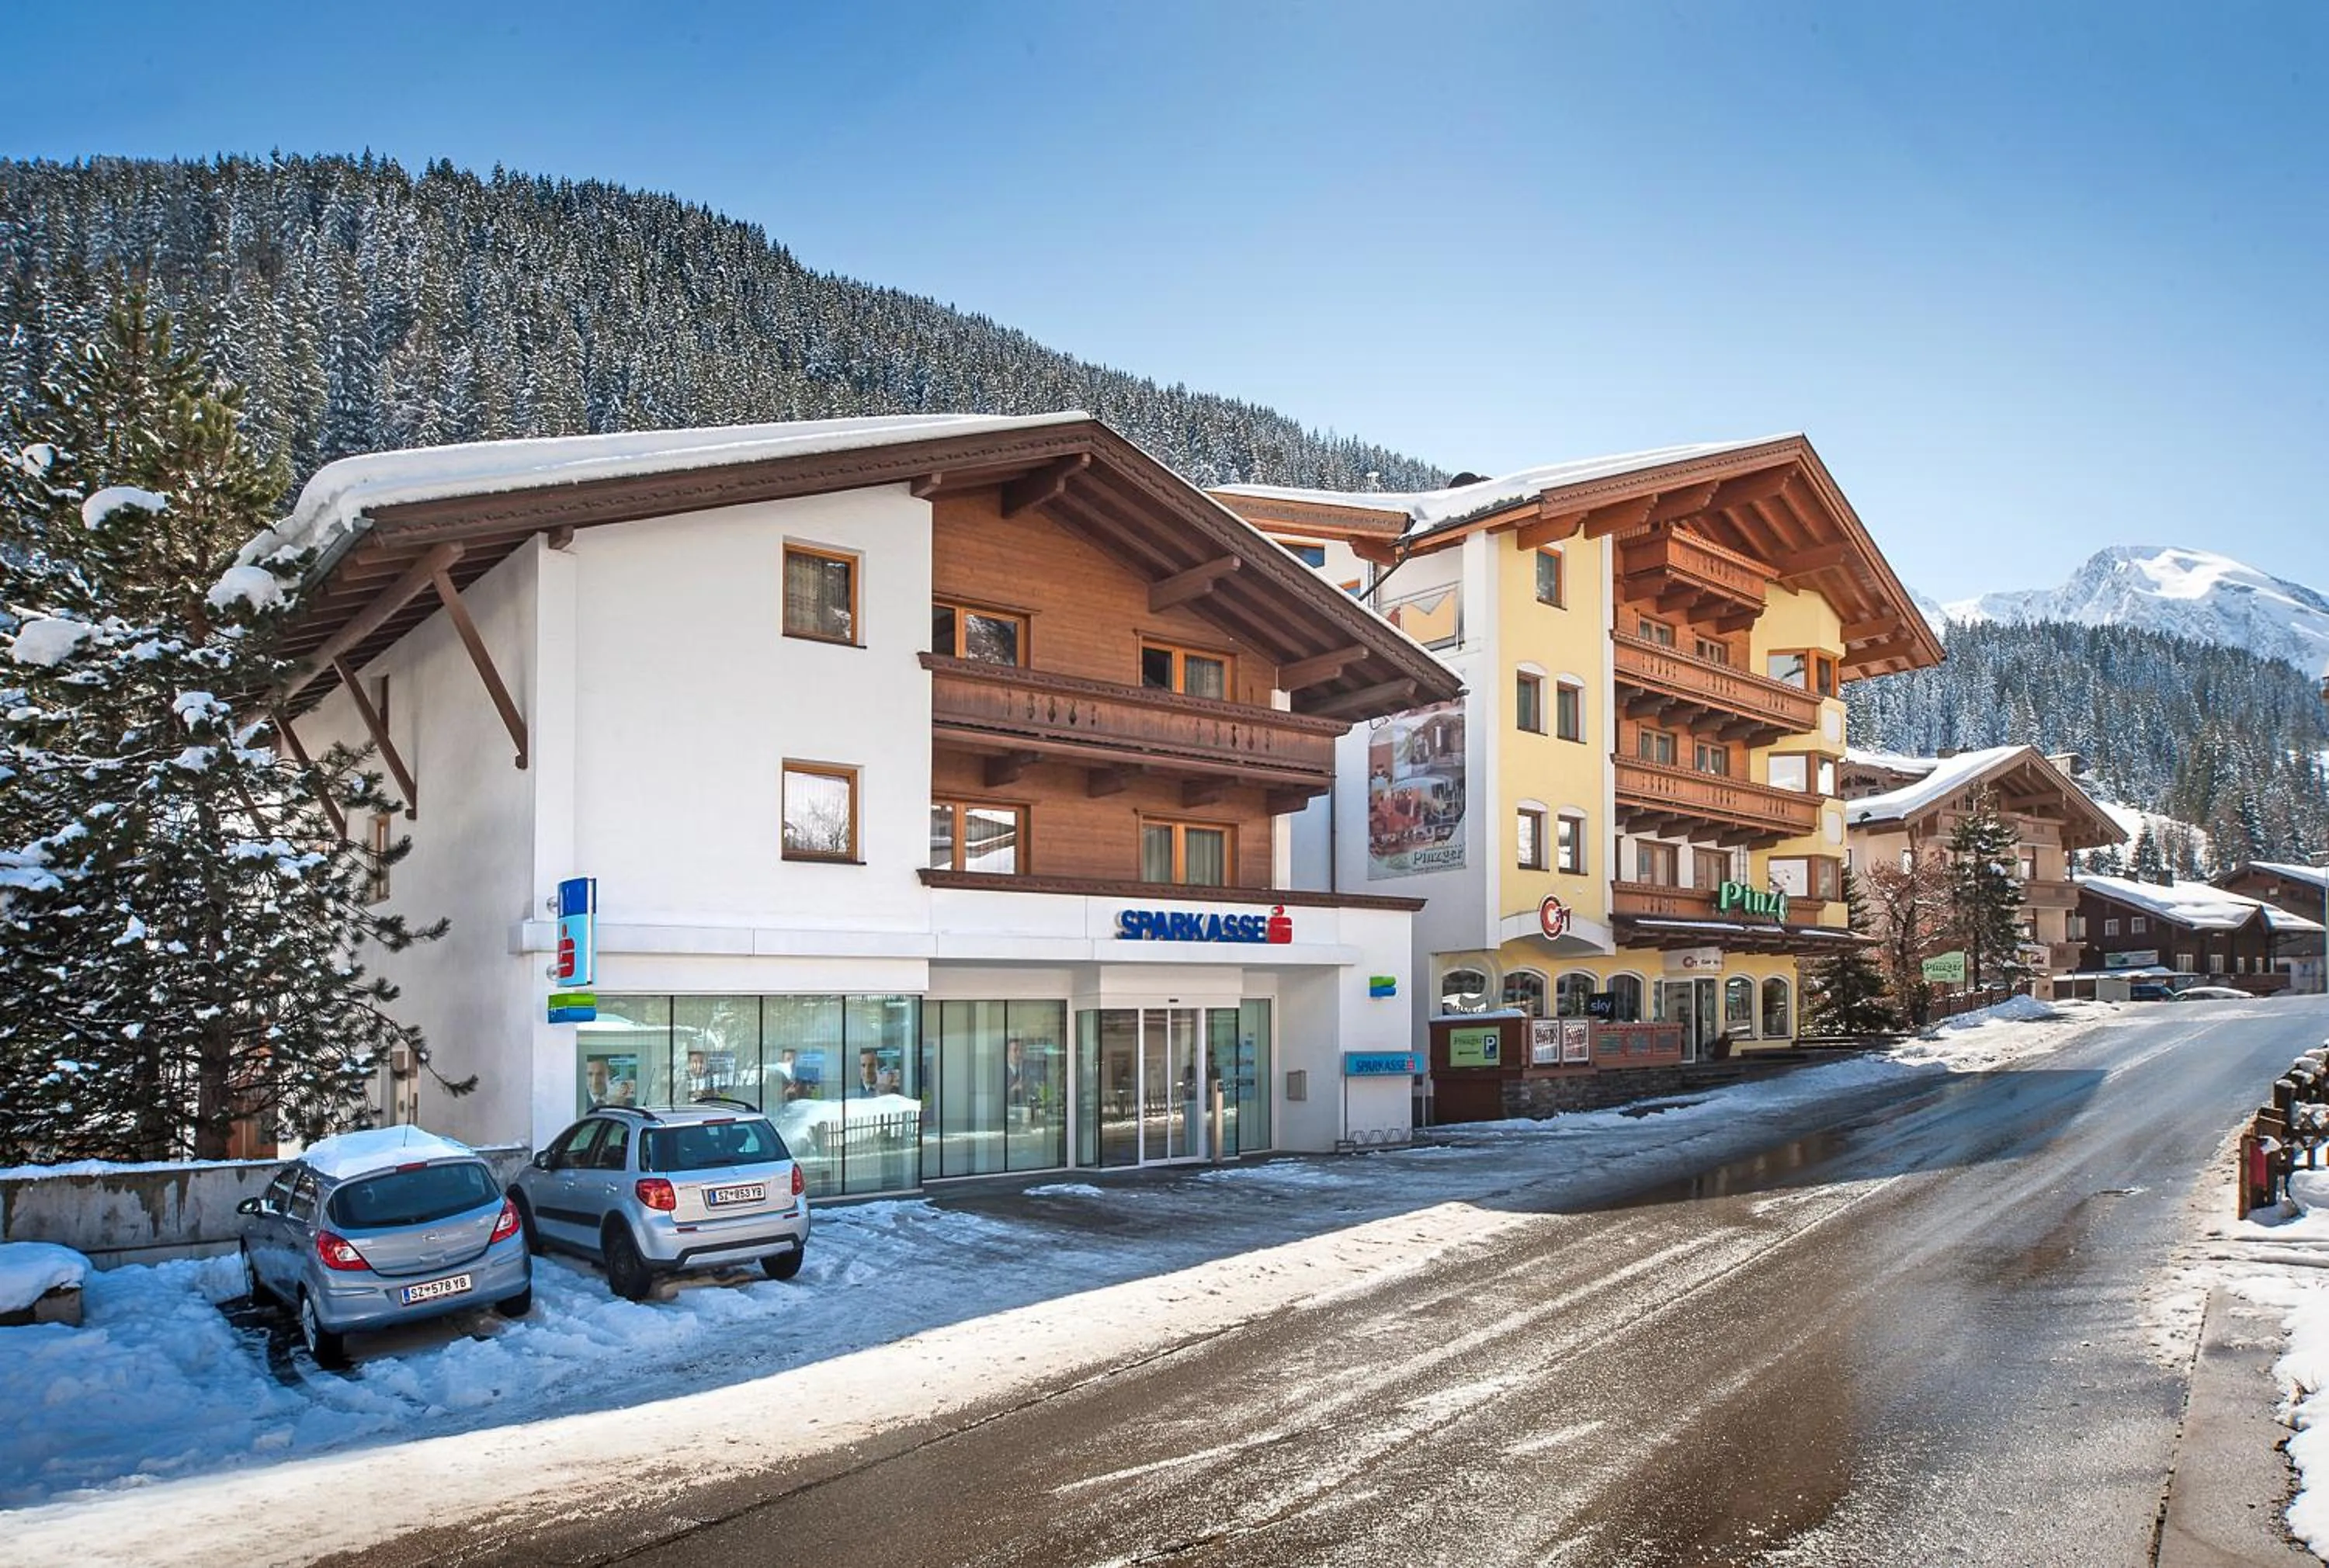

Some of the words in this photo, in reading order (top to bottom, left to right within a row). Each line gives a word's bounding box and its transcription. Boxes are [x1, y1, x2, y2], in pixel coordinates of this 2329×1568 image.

[1119, 909, 1267, 942] SPARKASSE
[1590, 999, 1612, 1013] sky
[1354, 1058, 1406, 1073] SPARKASSE
